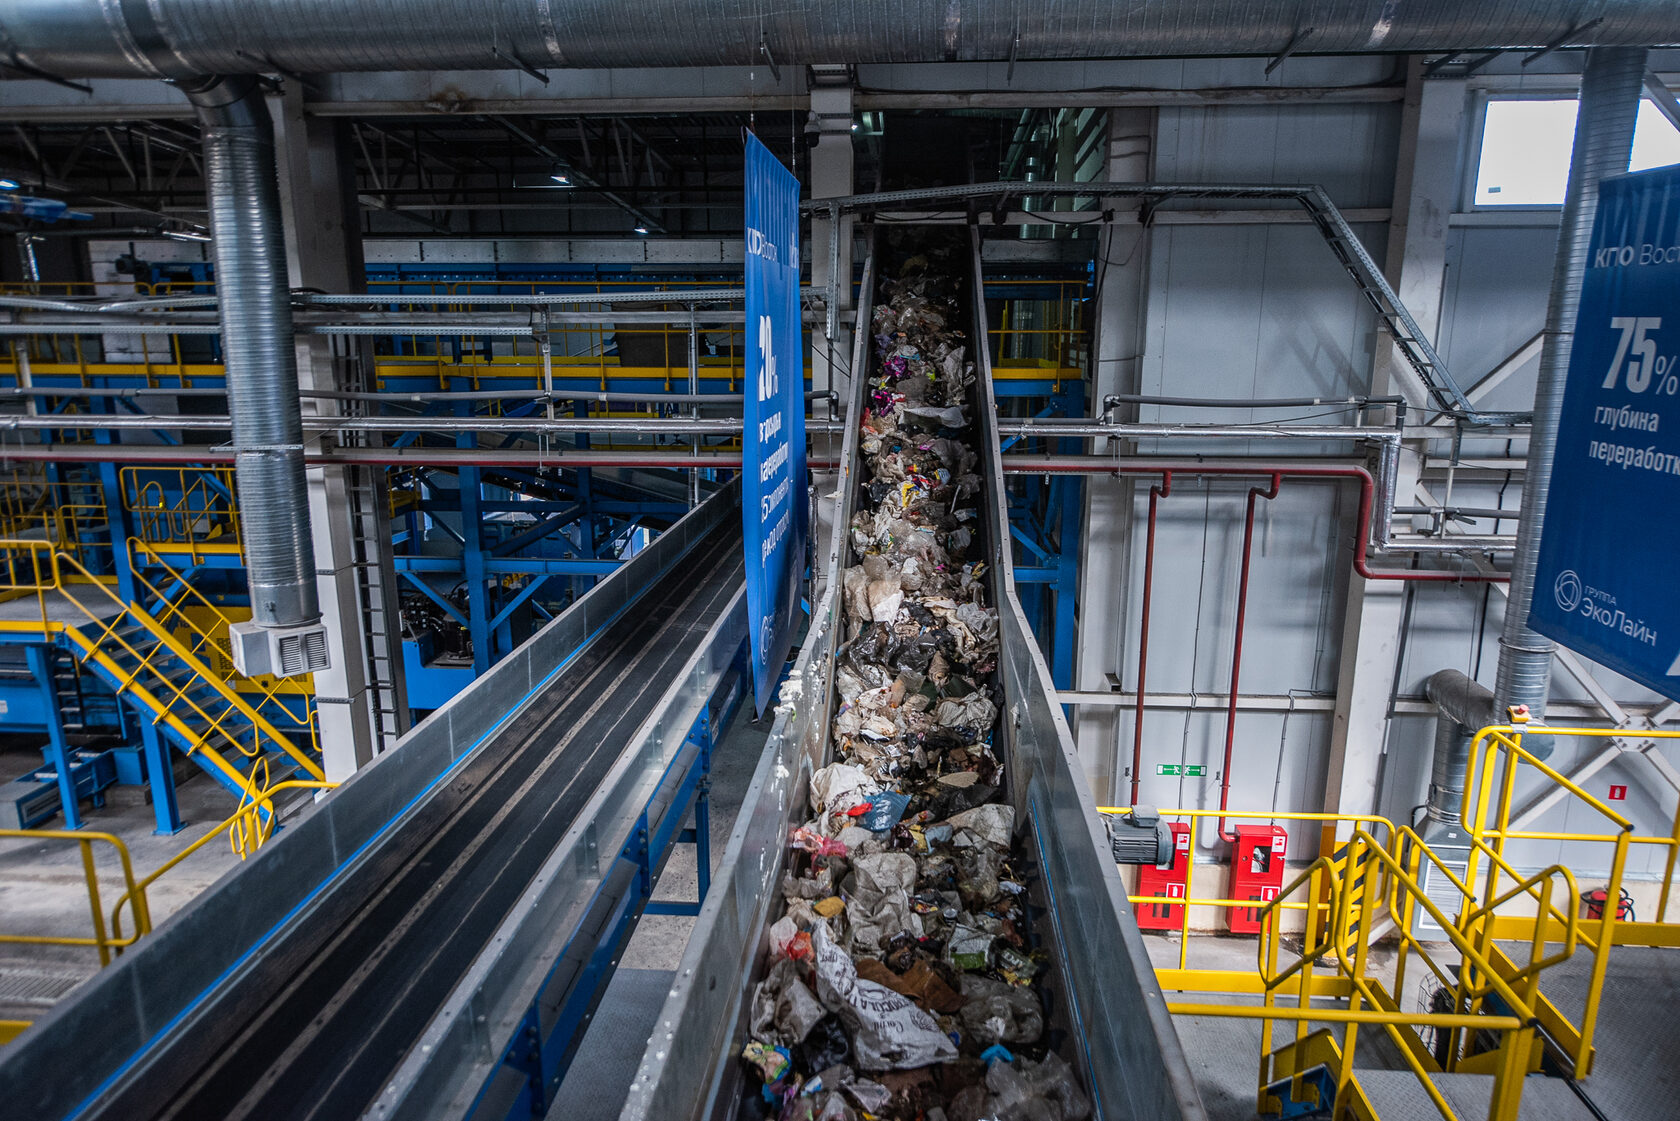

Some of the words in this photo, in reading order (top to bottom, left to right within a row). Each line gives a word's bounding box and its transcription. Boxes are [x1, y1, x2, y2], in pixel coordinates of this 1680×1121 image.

[1594, 245, 1634, 268] КПО
[1601, 316, 1679, 396] 75%
[1594, 404, 1660, 433] глубина
[1588, 440, 1680, 476] переработк
[1584, 585, 1617, 606] ГРУППА
[1580, 597, 1657, 647] ЭкоЛайн
